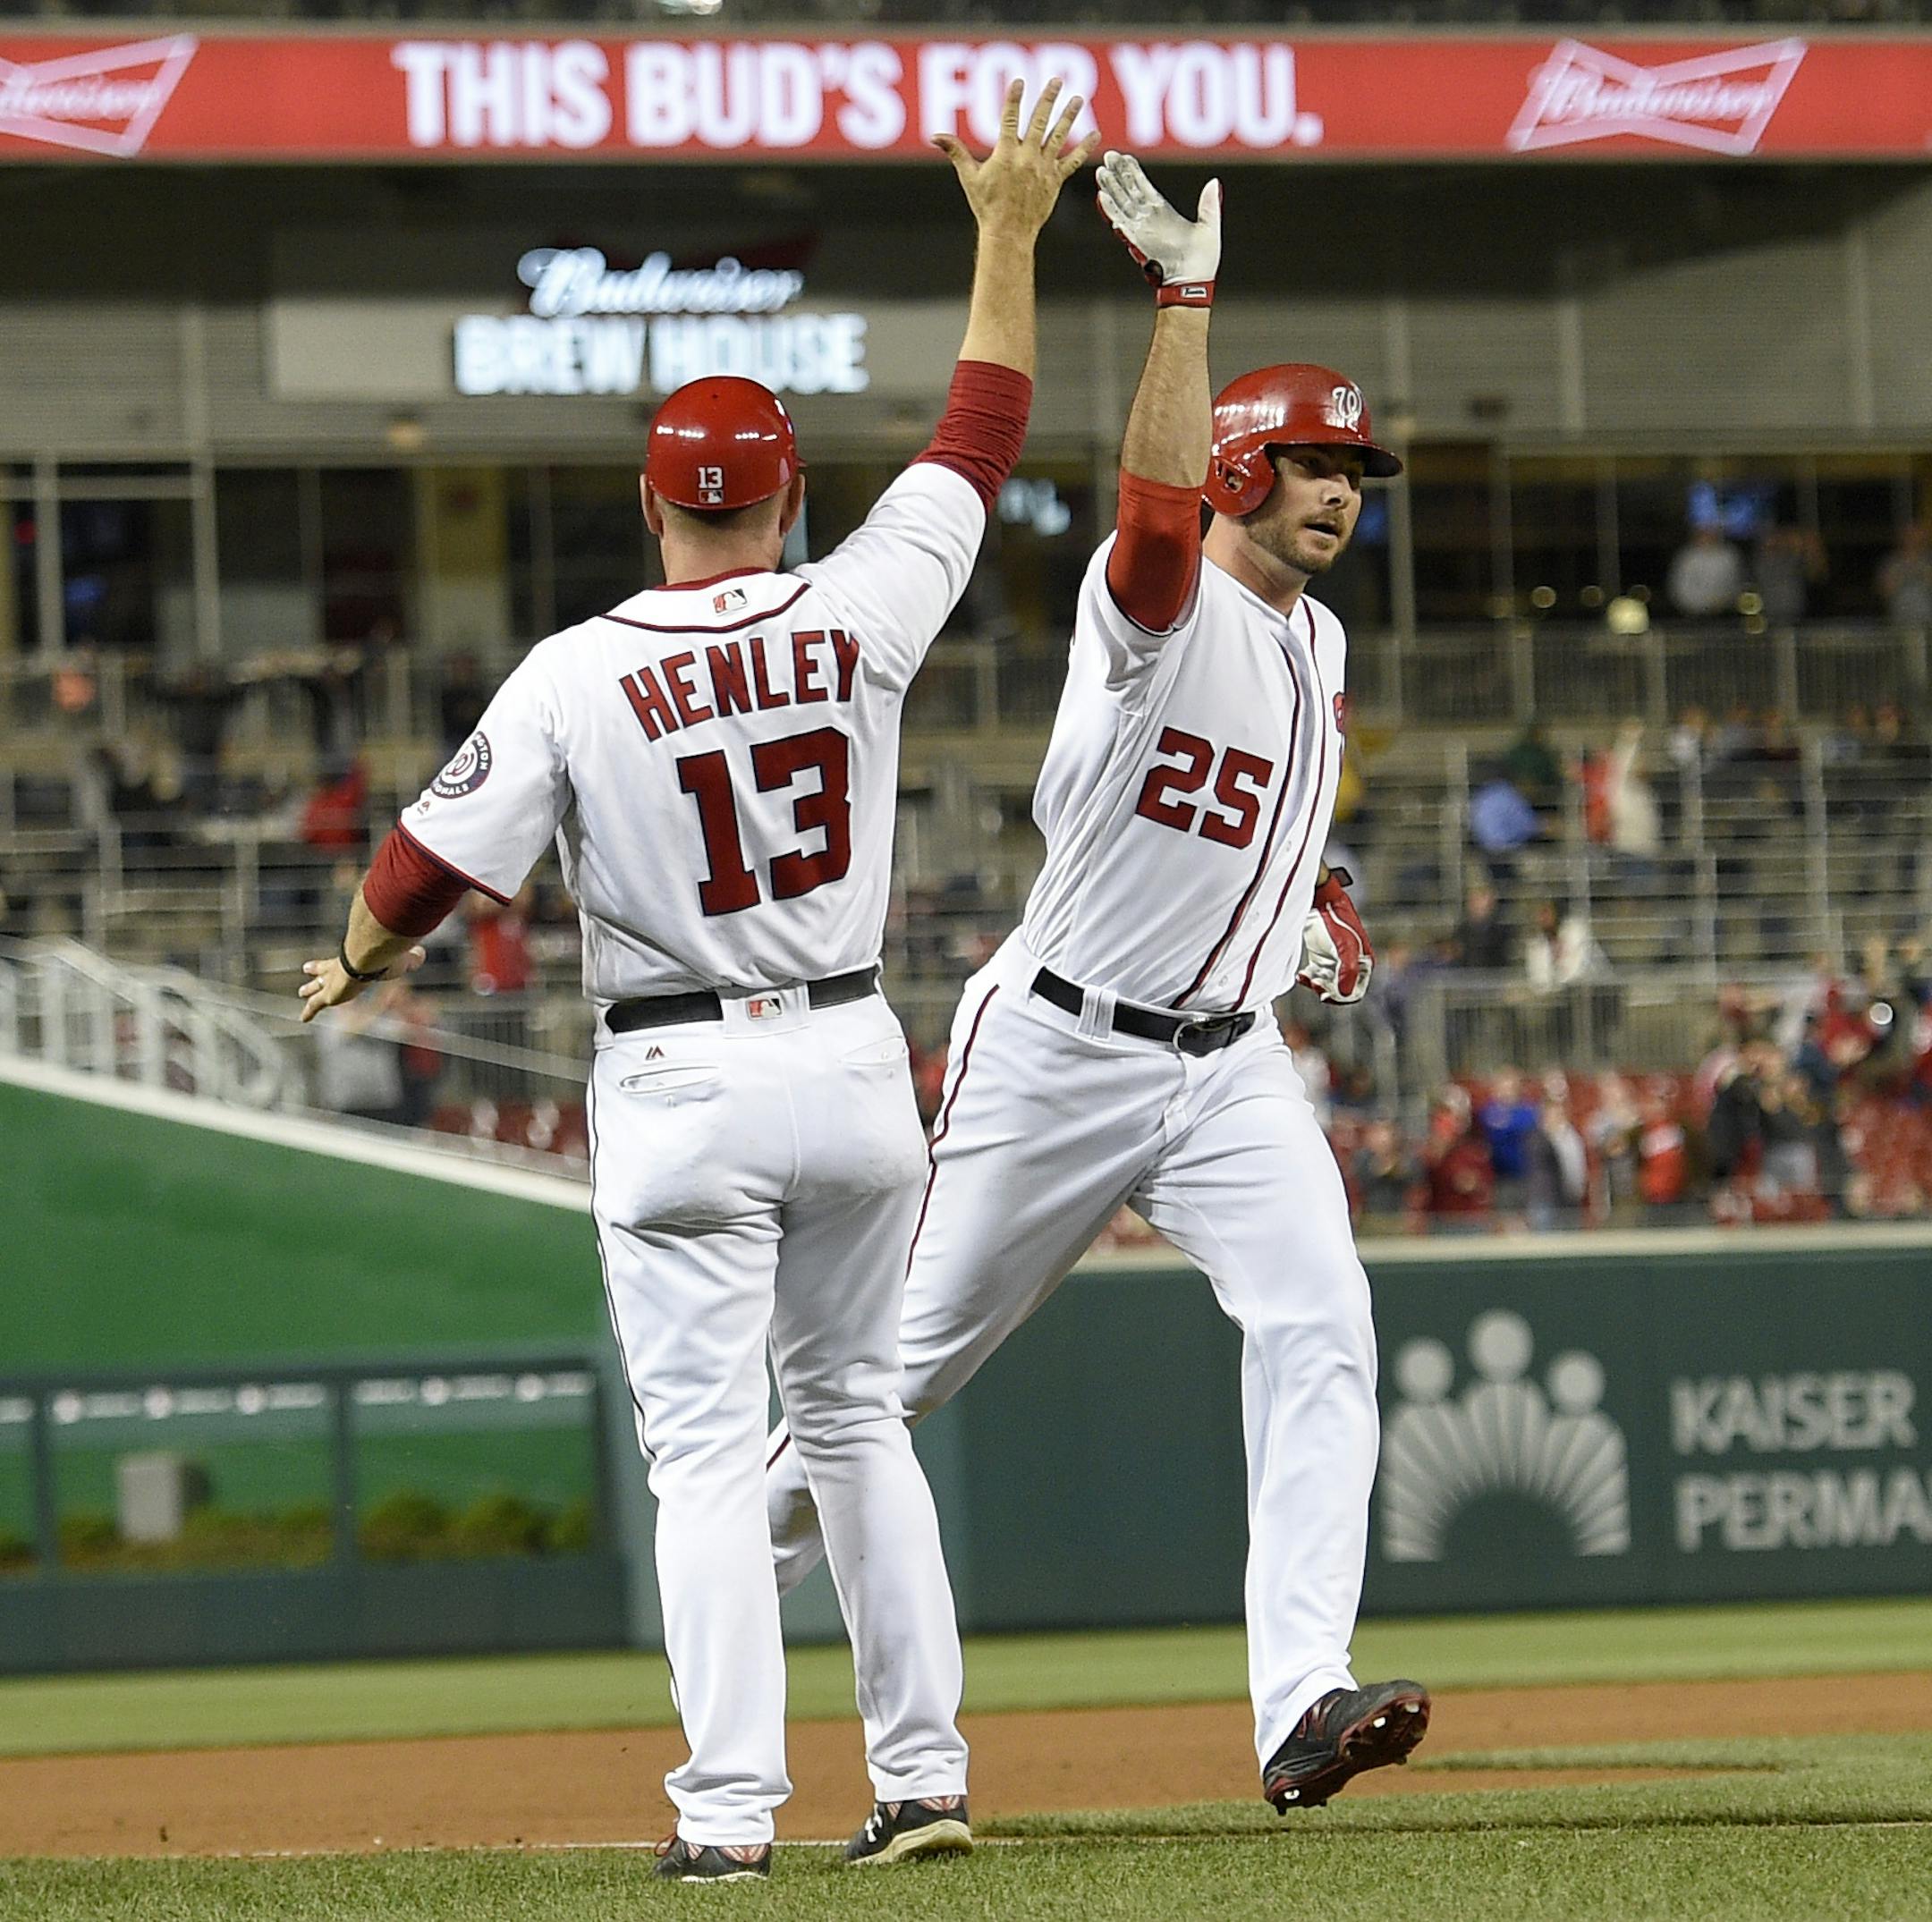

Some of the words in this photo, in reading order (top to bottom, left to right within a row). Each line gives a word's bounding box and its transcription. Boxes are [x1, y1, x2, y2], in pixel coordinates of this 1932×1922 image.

[391, 40, 613, 148] THIS
[626, 40, 906, 148] BUD'S
[919, 41, 1098, 148] FOR
[1108, 41, 1325, 148] YOU.
[517, 246, 804, 318] Budweiser
[453, 314, 648, 395] BREW
[649, 313, 870, 395] HOUSE
[697, 466, 723, 489] 13
[619, 629, 860, 743] HENLEY
[676, 726, 852, 917] 13
[1135, 726, 1275, 851] 25
[1670, 1369, 1918, 1454] KAISER
